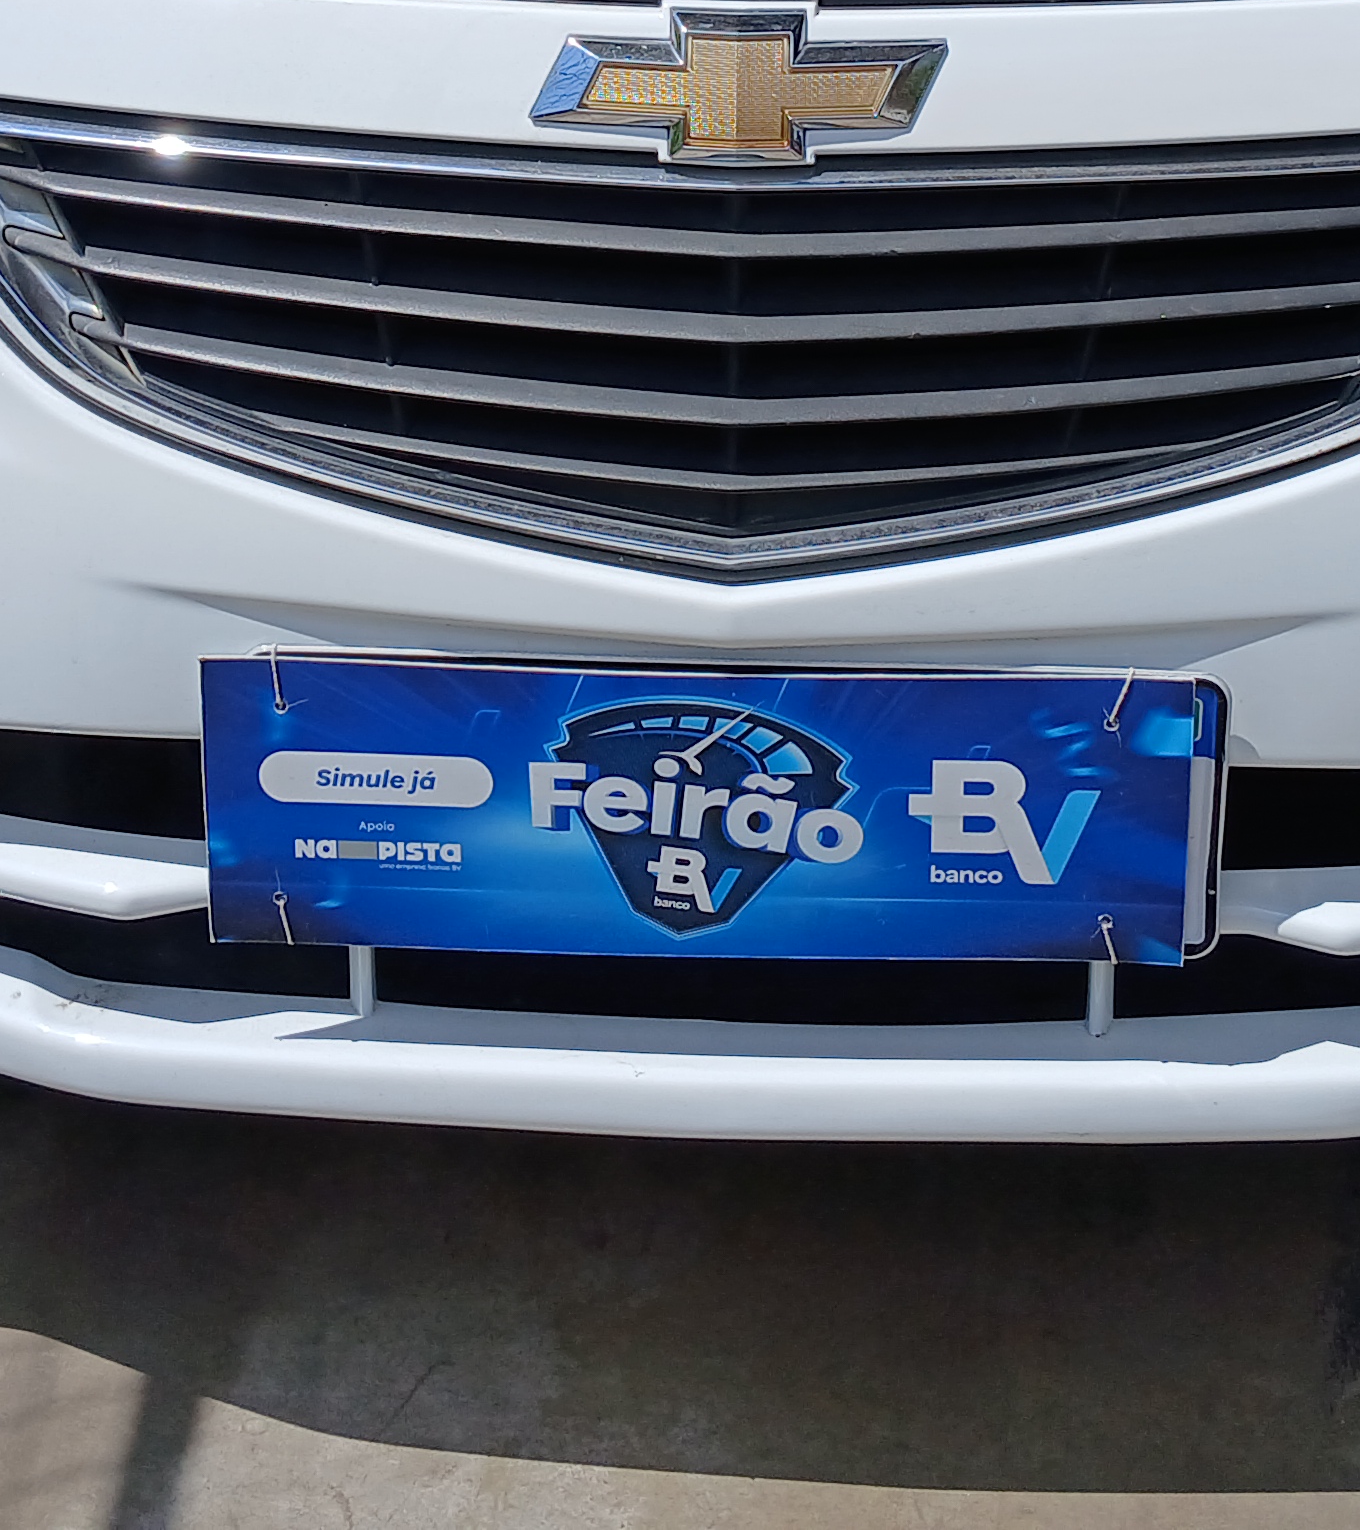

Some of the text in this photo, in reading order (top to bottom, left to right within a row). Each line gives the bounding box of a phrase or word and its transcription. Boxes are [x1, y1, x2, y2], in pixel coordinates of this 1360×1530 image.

[315, 768, 437, 794] Simule já
[528, 754, 864, 864] Feirão
[928, 865, 1004, 886] banco
[653, 896, 691, 911] banco
